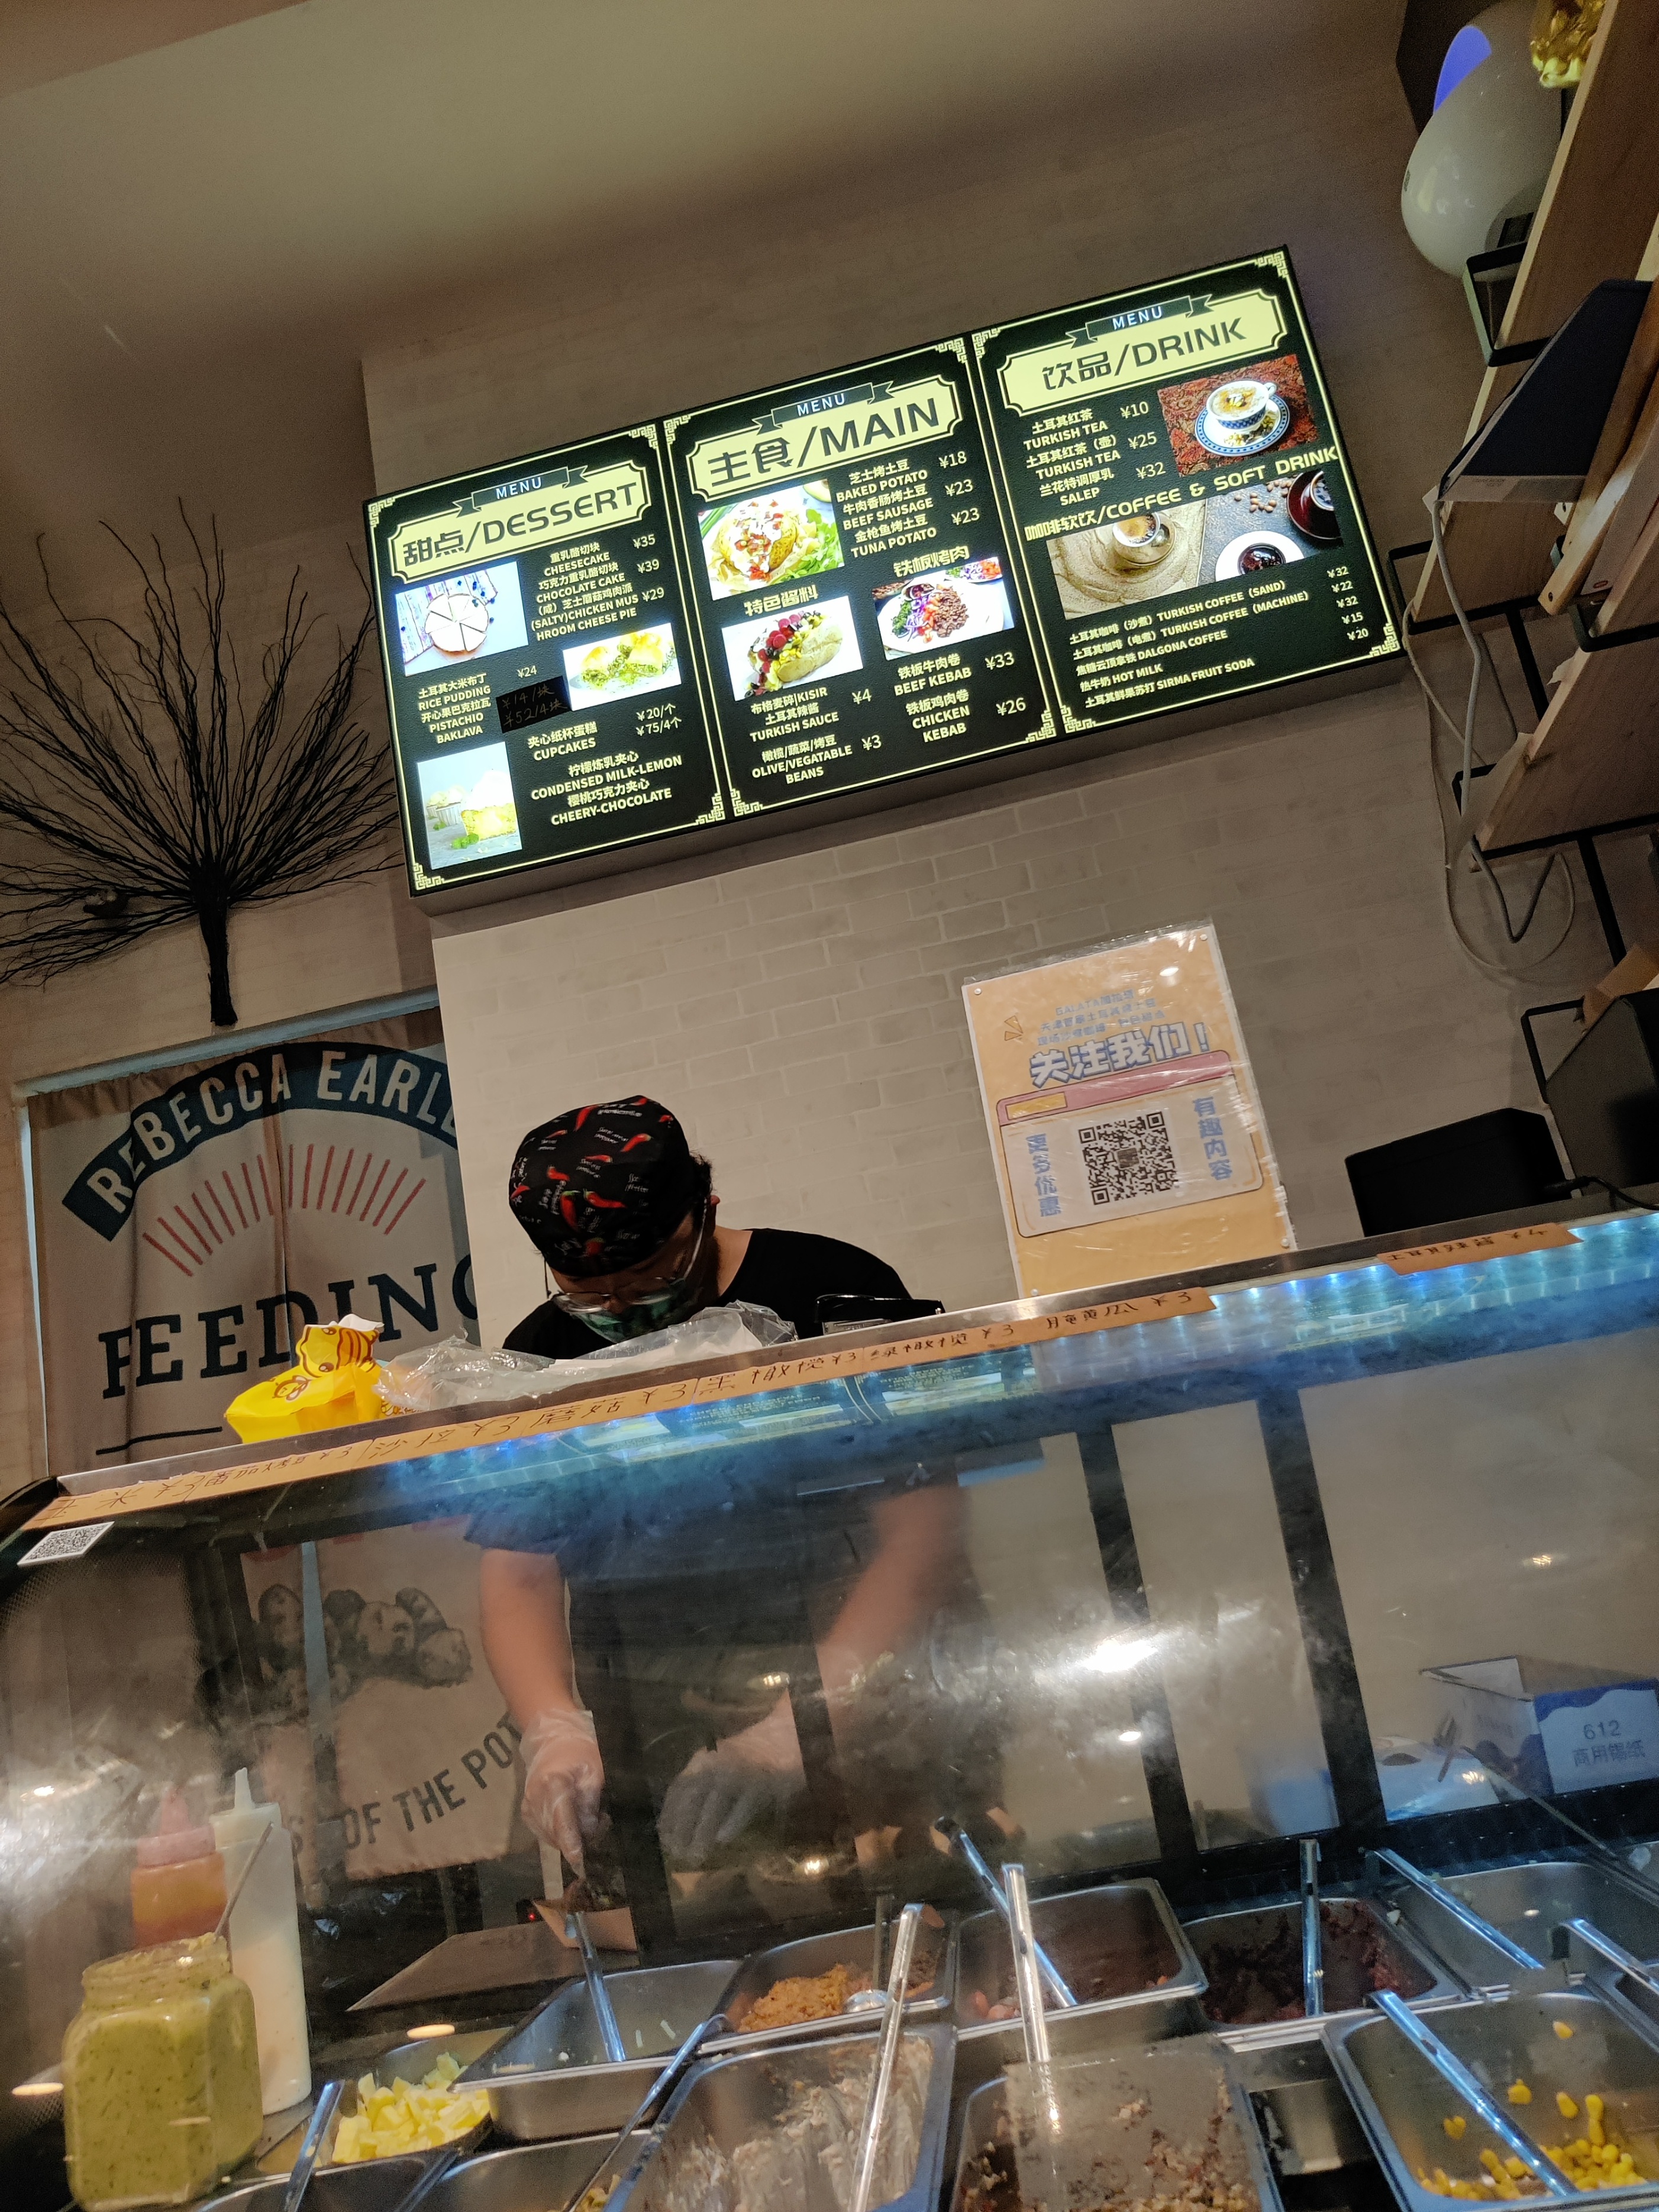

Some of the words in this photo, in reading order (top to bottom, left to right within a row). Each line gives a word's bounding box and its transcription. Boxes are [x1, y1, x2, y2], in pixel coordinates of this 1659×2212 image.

[1112, 306, 1163, 330] MENU
[1042, 317, 1247, 391] 饮品/DRINK
[797, 394, 845, 417] MENU
[1024, 427, 1081, 451] TURKISH
[1083, 420, 1108, 437] TEA
[1031, 408, 1093, 434] 土耳其红茶
[708, 398, 940, 487] 主食/MAIN
[848, 459, 909, 485] 芝士烤土豆
[1035, 457, 1093, 481] TURKISH
[1095, 450, 1121, 466] TEA
[1189, 483, 1205, 497] &
[1213, 466, 1266, 492] SOFT
[1276, 446, 1339, 475] DRINK
[496, 478, 542, 499] MENU
[836, 484, 877, 502] BAKED
[880, 469, 928, 490] POTATO
[1040, 467, 1114, 498] 兰花特调厚乳
[1060, 488, 1100, 507] SALEP
[843, 484, 927, 515] 牛肉香肠烤土豆
[843, 511, 874, 530] BEEF
[876, 498, 934, 521] SAUSAGE
[403, 482, 637, 567] 甜点/DESSERT
[854, 516, 928, 544] 金枪鱼烤土豆
[550, 542, 600, 563] 重乳酪切块
[851, 539, 886, 558] TUNA
[889, 528, 937, 549] POTATO
[538, 562, 619, 591] 巧克力重乳酪切块
[544, 552, 611, 576] CHEESECAKE
[893, 546, 969, 577] 铁板烤肉
[536, 579, 596, 603] CHOCOLATE
[597, 573, 626, 589] CAKE
[615, 595, 638, 611] MUS
[744, 585, 818, 616] 特色酱料
[1157, 601, 1203, 622] TURKISH
[1205, 592, 1245, 610] COFFEE
[537, 624, 576, 641] HROOM
[577, 614, 618, 633] CHEESE
[619, 607, 637, 623] PIE
[1160, 617, 1207, 638] TURKISH
[1209, 608, 1248, 625] COFFEE
[1138, 640, 1187, 660] DALGONA
[1188, 630, 1228, 648] COFFEE
[893, 678, 927, 696] BEEF
[928, 666, 972, 688] KEBAB
[898, 653, 961, 680] 铁板牛肉卷
[1079, 675, 1111, 693] 热牛奶
[1112, 670, 1135, 686] HOT
[1137, 663, 1163, 679] MILK
[417, 673, 487, 699] 土耳其大米布丁
[418, 697, 442, 711] RICE
[443, 685, 491, 705] PUDDING
[1084, 681, 1156, 709] 土耳其鲜果苏打
[1156, 674, 1191, 692] SIRMA
[1192, 665, 1222, 683] FRUIT
[1224, 658, 1255, 675] SODA
[421, 697, 492, 724] 开心果巴克拉瓦
[764, 702, 819, 726] 土耳其辣酱
[905, 688, 969, 716] 铁板鸡肉卷
[429, 712, 484, 734] PISTACHIO
[750, 720, 800, 742] TURKISH
[802, 711, 840, 730] SAUCE
[912, 705, 970, 730] CHICKEN
[923, 722, 967, 743] KEBAB
[436, 725, 483, 744] BAKLAVA
[528, 722, 598, 749] 夹心纸杯蛋糕
[533, 738, 596, 761] CUPCAKES
[568, 750, 639, 777] 柠檬炼乳夹心
[751, 744, 853, 779] OLIVE/VEGATABLE
[785, 766, 824, 785] BEANS
[531, 774, 604, 801] CONDENSED
[606, 755, 682, 783] MILK-LEMON
[567, 778, 650, 808] 樱桃巧克力夹心
[551, 788, 672, 826] CHEERY-CHOCOLATE
[86, 1052, 291, 1215] REBECCA
[1192, 1096, 1233, 1181] 有趣内容
[1583, 1720, 1622, 1740] 612
[342, 1801, 382, 1850] OF
[392, 1769, 466, 1833] THE
